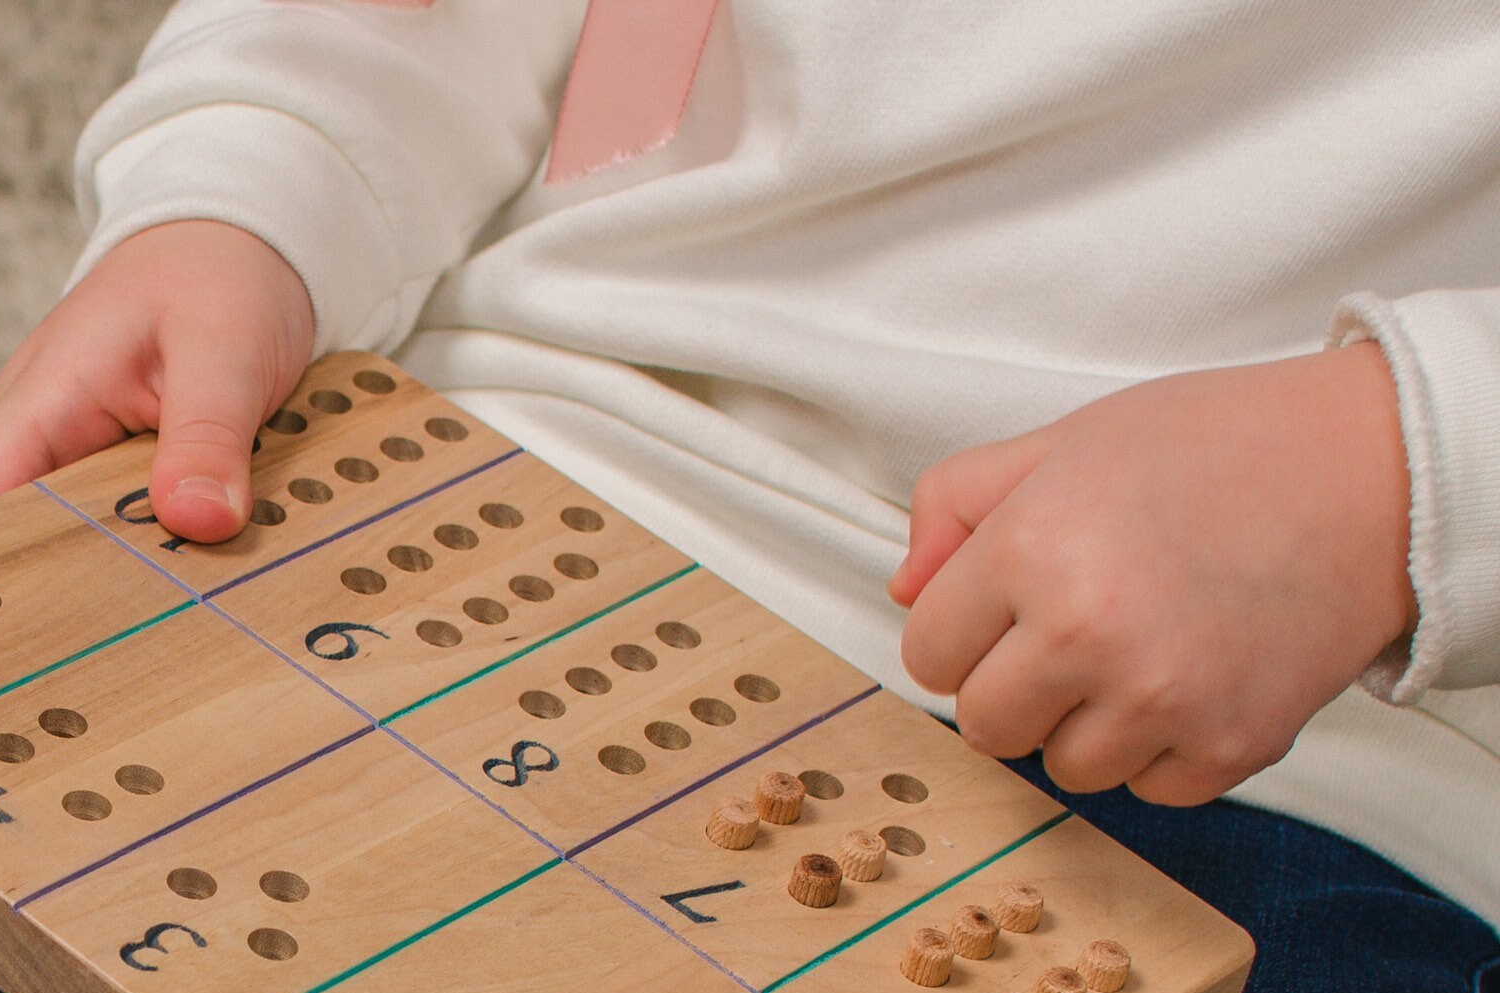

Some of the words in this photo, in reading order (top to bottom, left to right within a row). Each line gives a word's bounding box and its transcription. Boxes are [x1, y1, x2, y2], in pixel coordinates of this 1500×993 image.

[482, 739, 560, 788] 8
[660, 879, 746, 925] 7
[119, 922, 208, 972] 3
